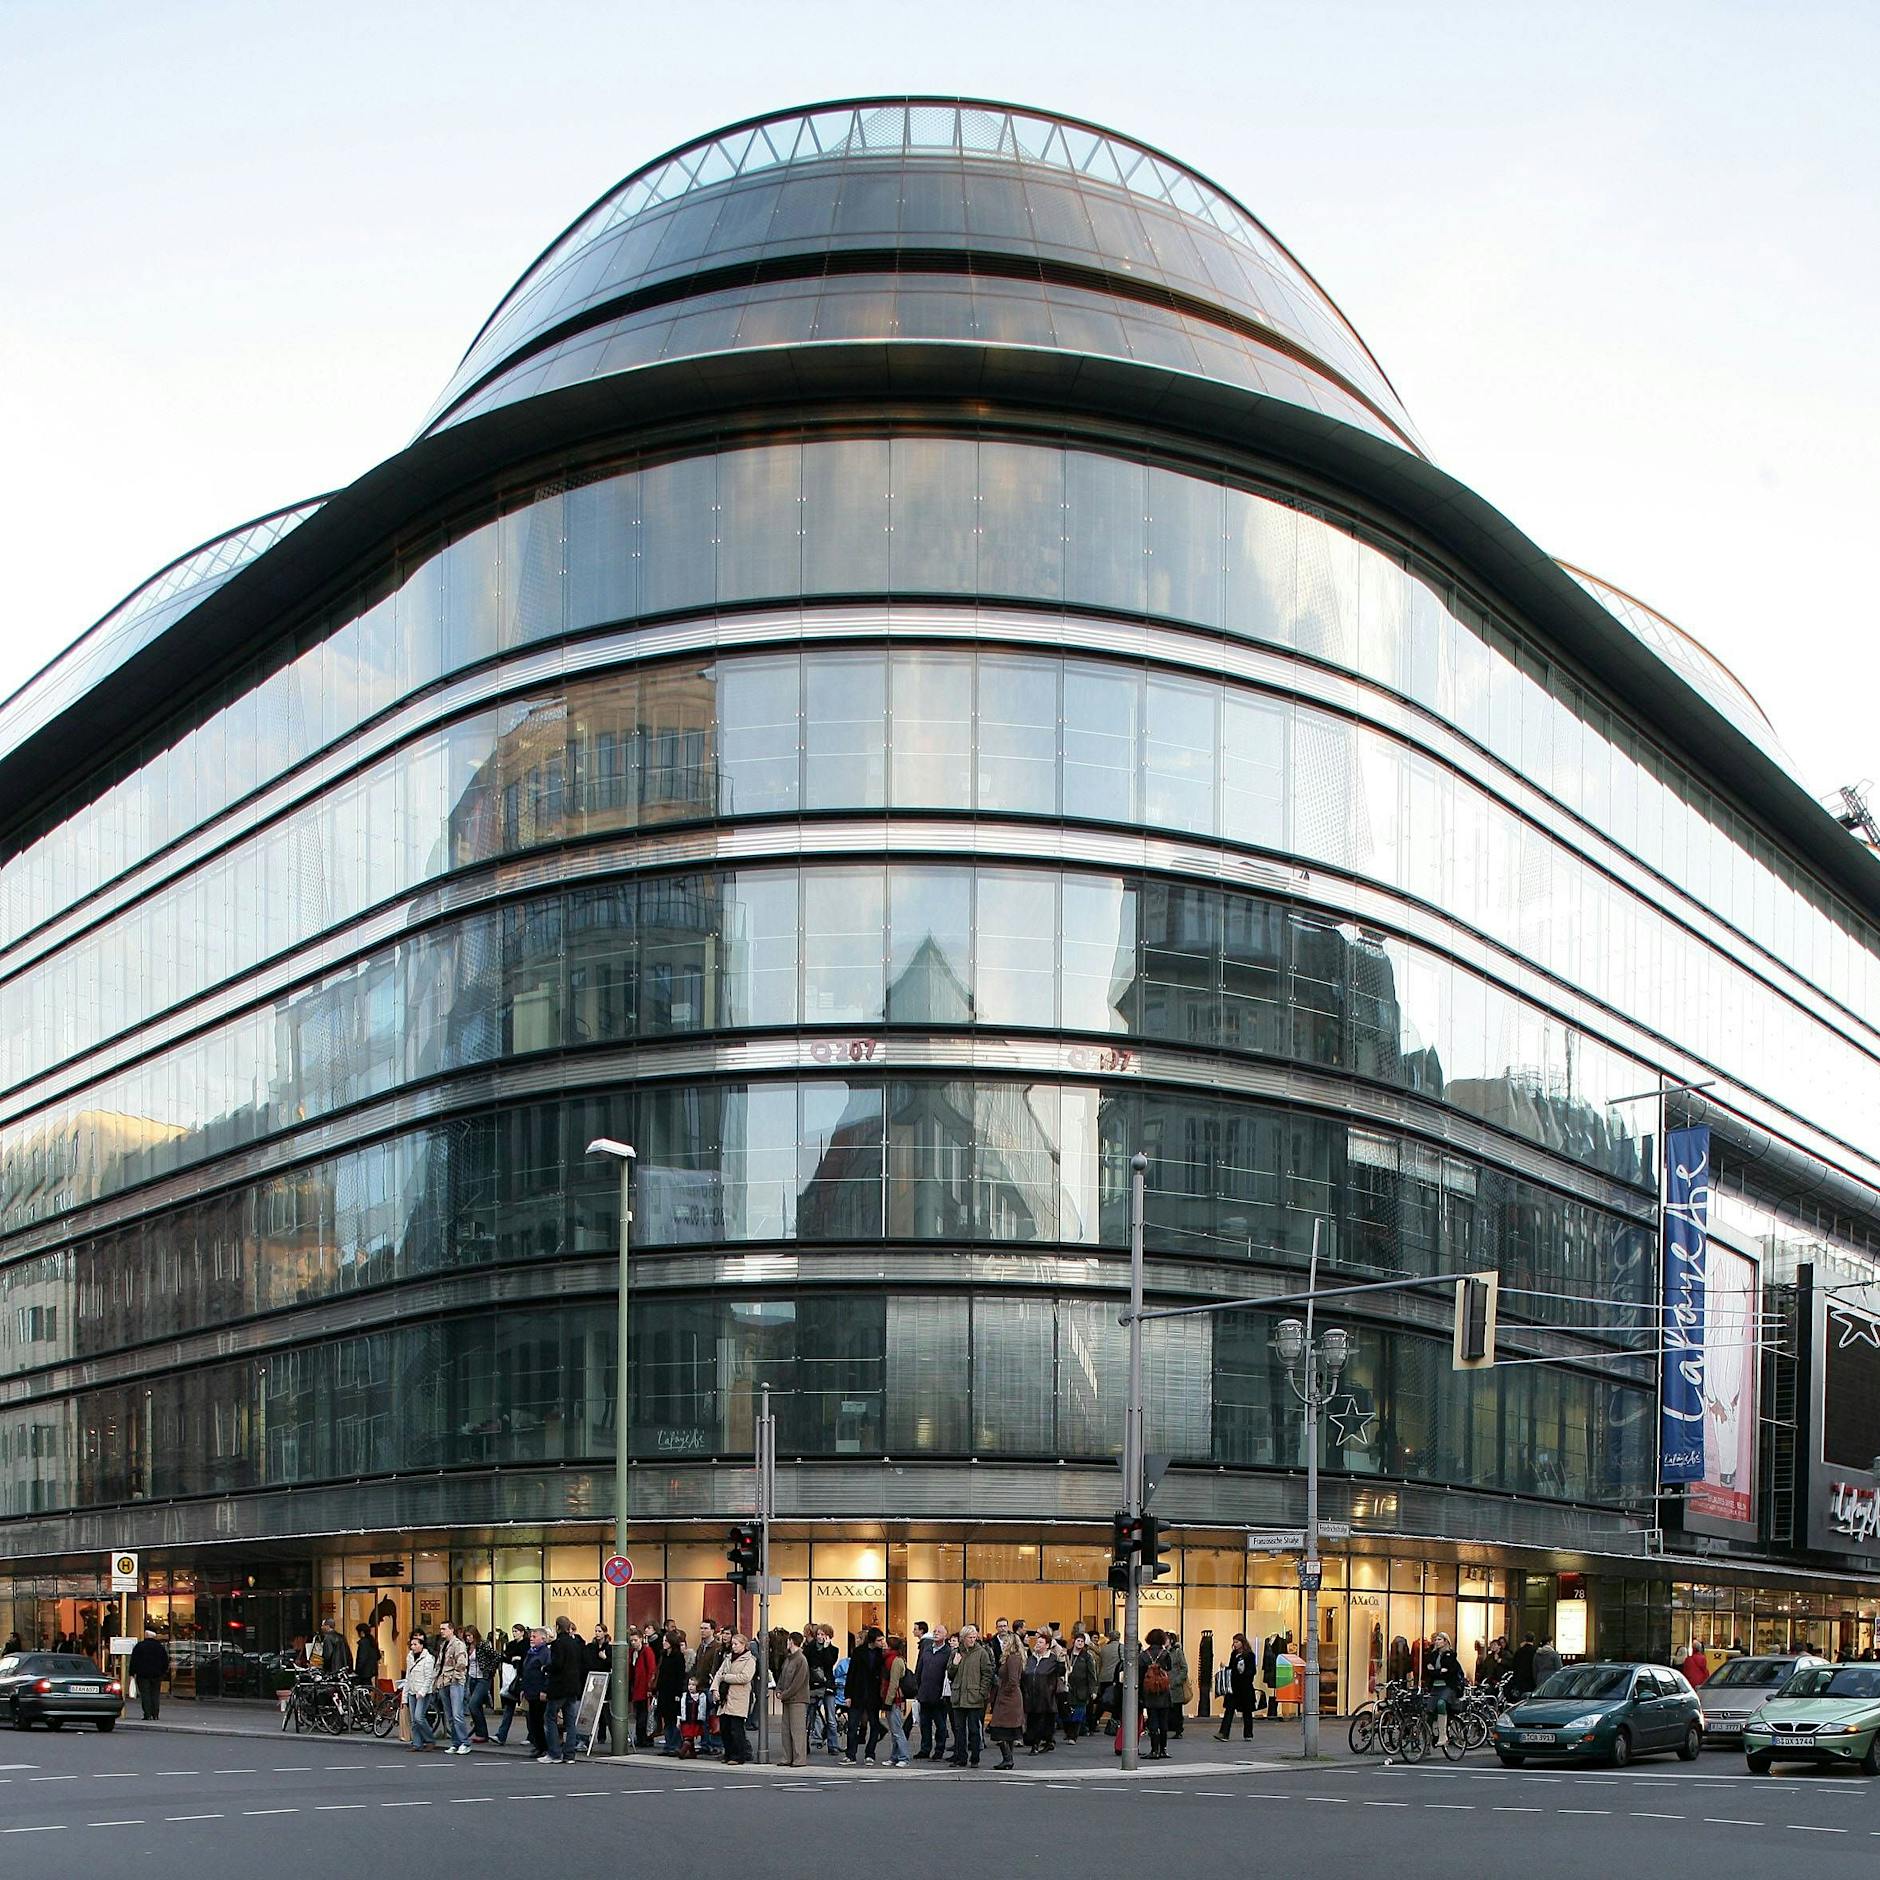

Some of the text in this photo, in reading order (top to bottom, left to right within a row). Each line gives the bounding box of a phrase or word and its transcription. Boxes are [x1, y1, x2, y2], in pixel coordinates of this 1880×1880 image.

[817, 1585, 885, 1597] MAX&Co.
[1115, 1589, 1175, 1601] MX&Co.
[1574, 1589, 1585, 1599] 78
